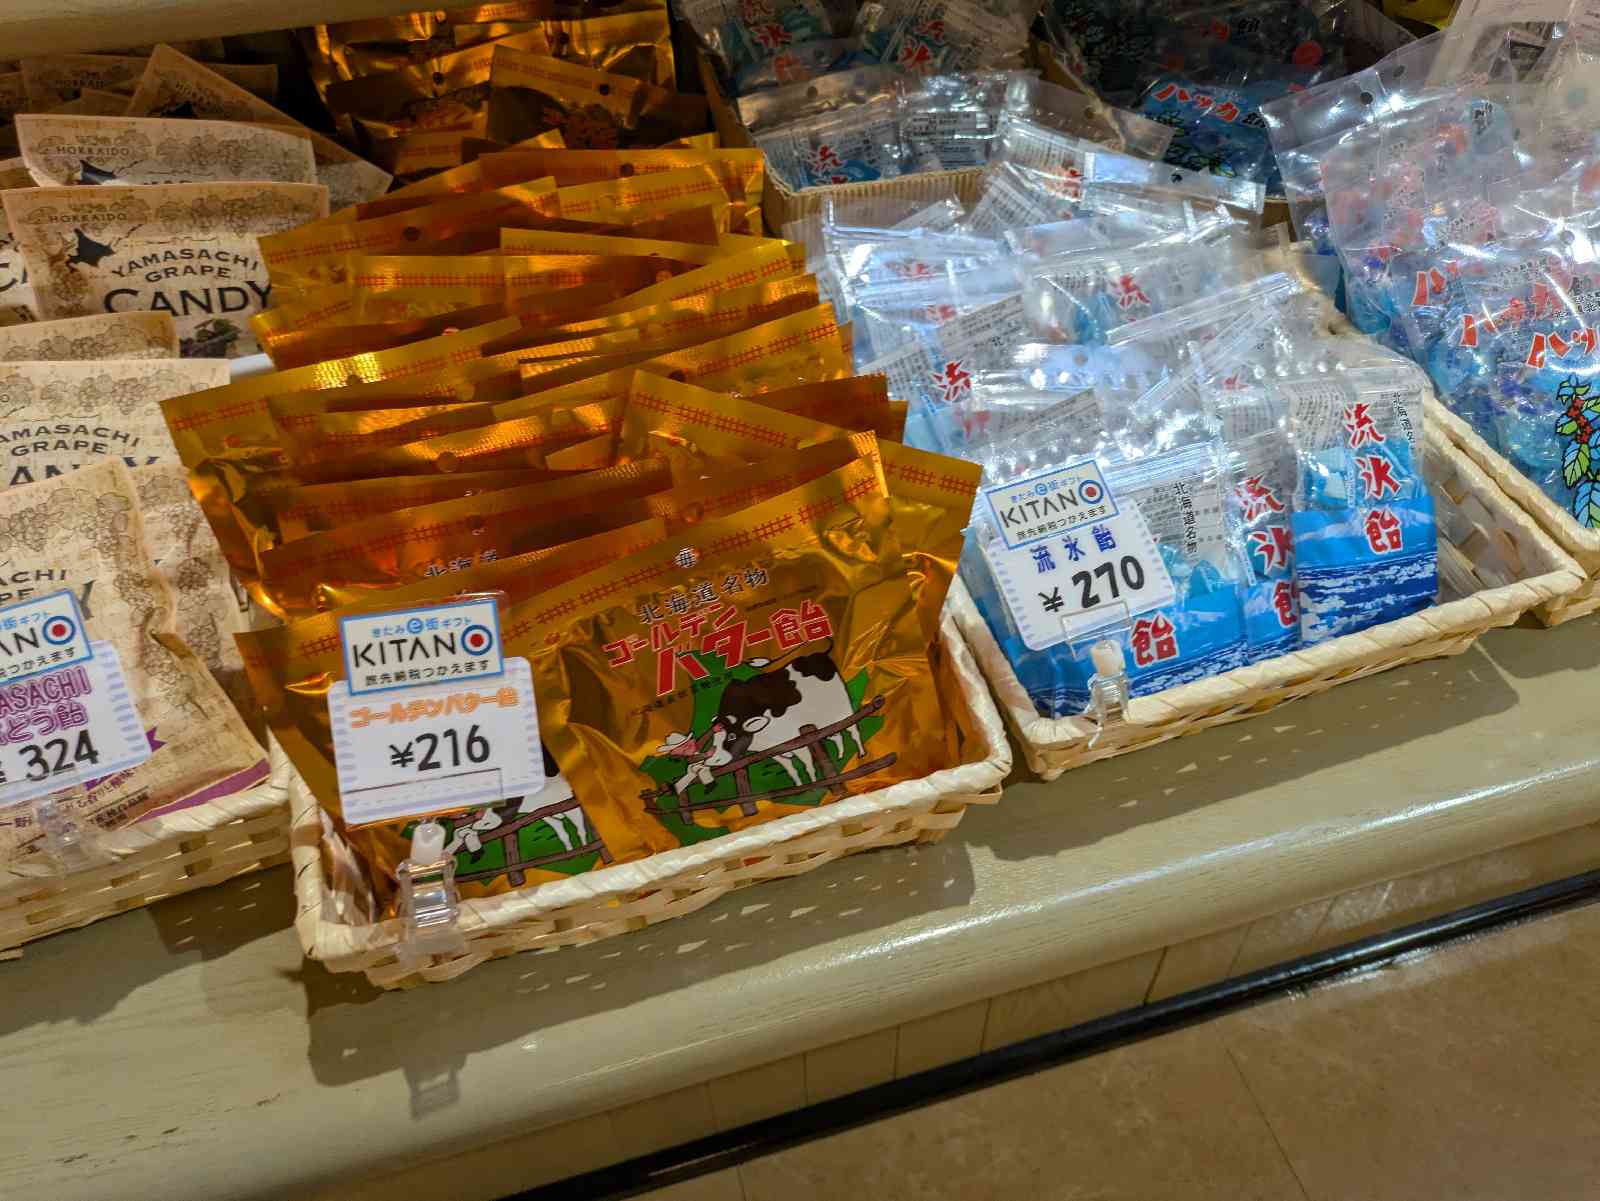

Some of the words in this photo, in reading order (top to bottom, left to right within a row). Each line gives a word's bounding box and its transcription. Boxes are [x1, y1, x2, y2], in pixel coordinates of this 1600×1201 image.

[55, 146, 130, 156] HOKKAIDO
[111, 248, 260, 279] YAMASACHI
[145, 265, 232, 283] GRAPE
[104, 280, 272, 318] CANDY
[11, 440, 108, 457] GRAPE
[1000, 480, 1104, 528] KITANO
[639, 567, 769, 625] 北海道名物
[353, 624, 494, 668] KITANO
[602, 602, 738, 668] ゴールデン
[656, 599, 834, 697] バター飴
[0, 701, 89, 746] どう飴
[388, 724, 490, 771] ¥216
